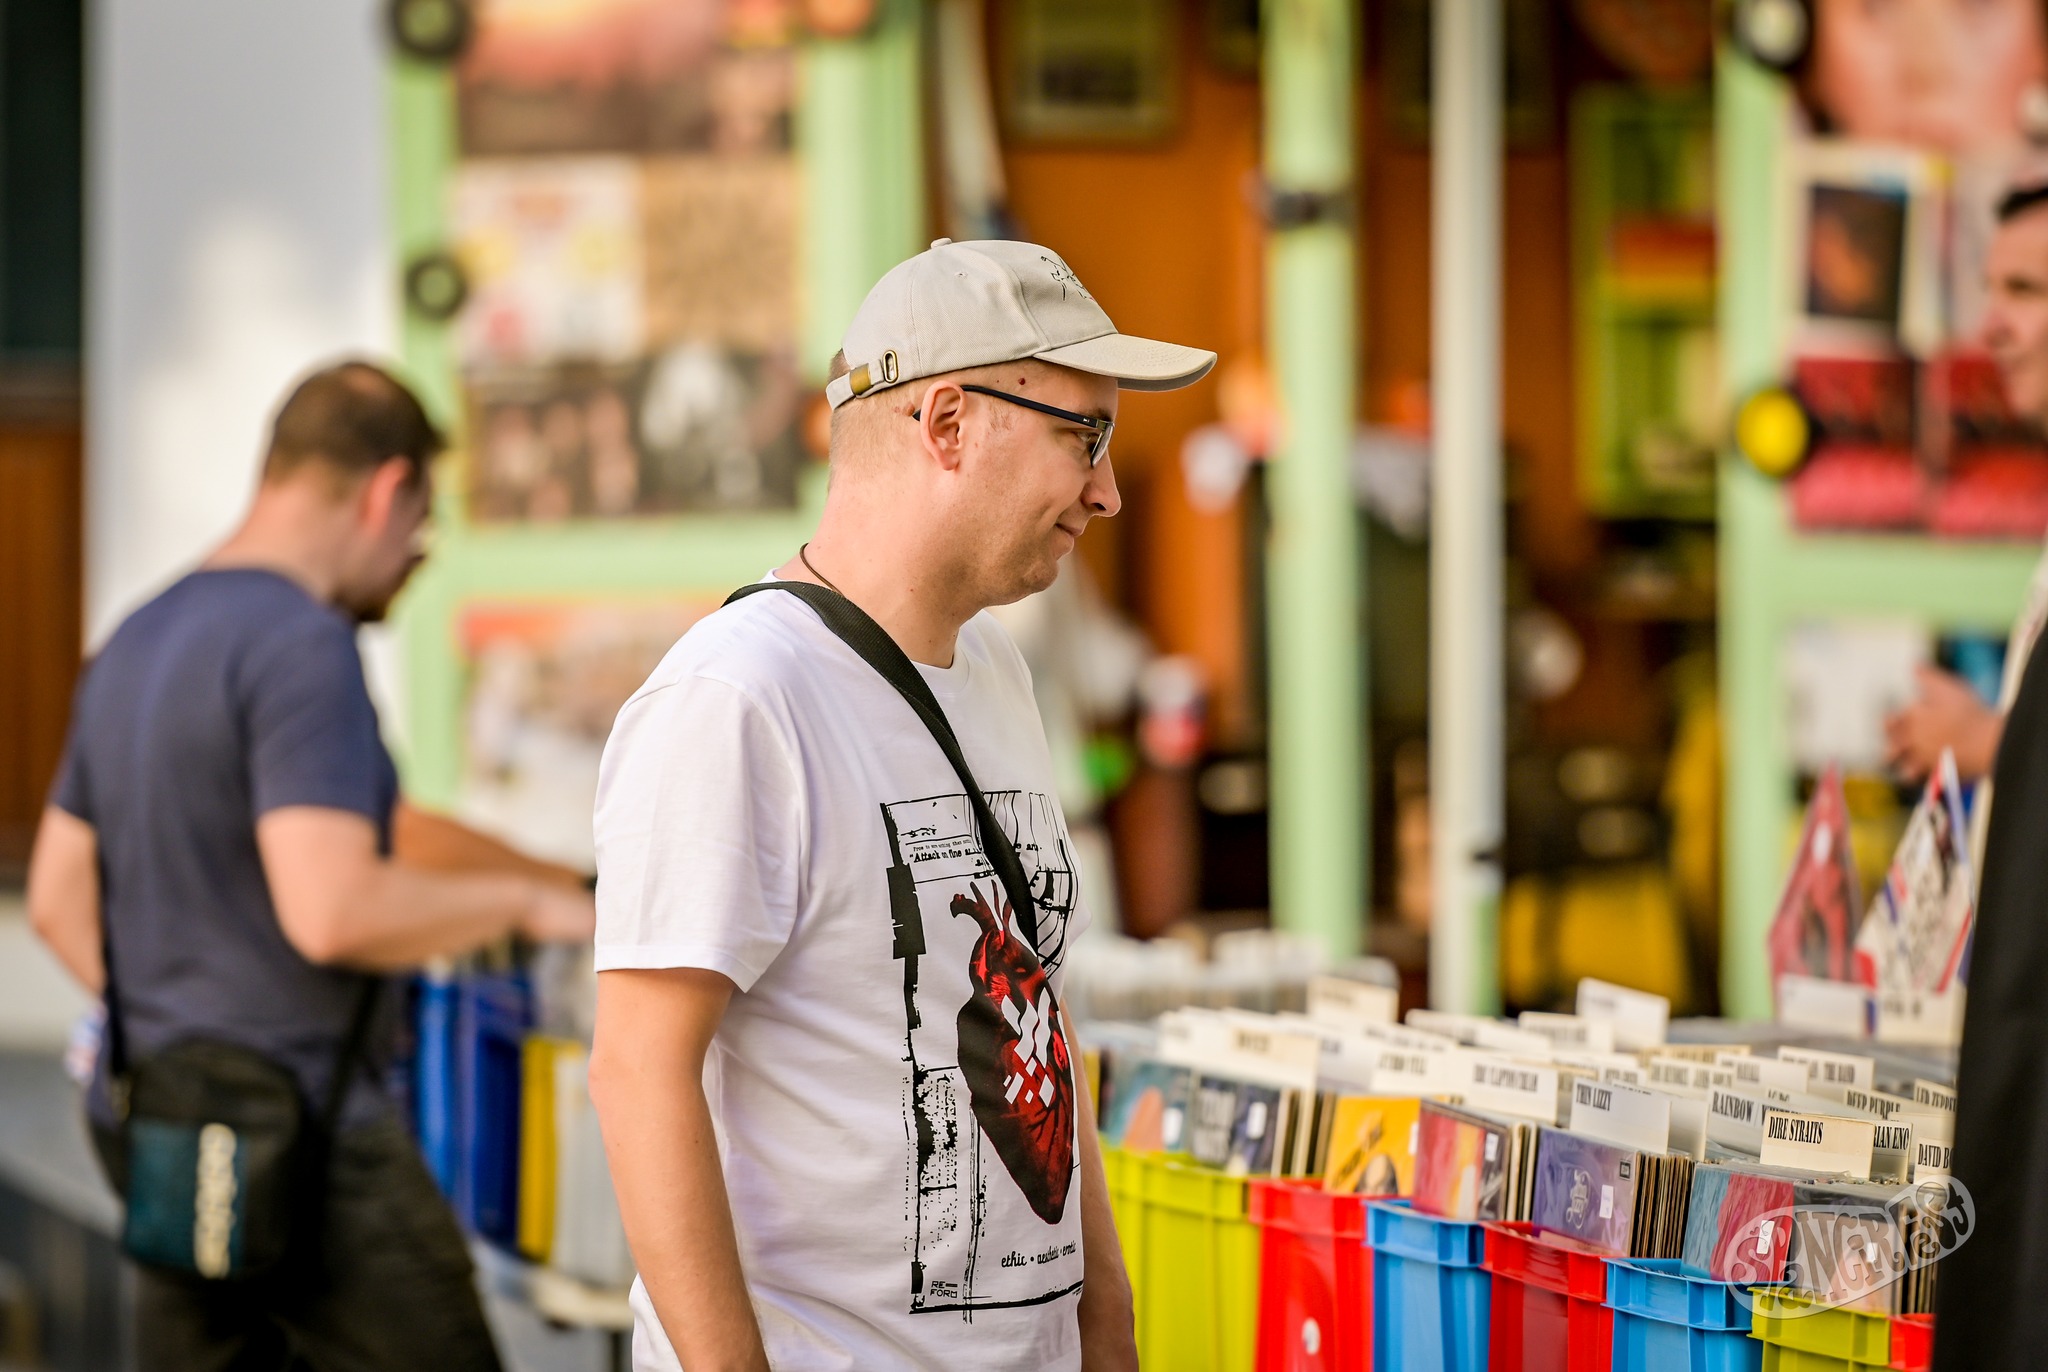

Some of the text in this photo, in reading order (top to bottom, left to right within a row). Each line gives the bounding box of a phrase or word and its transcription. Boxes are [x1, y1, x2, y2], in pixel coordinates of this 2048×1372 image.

[949, 849, 962, 858] fine
[1576, 1083, 1592, 1106] THIN
[1593, 1087, 1612, 1111] LIZZY
[1712, 1091, 1754, 1123] RAINBOW
[1847, 1090, 1868, 1110] DEEP
[1768, 1116, 1824, 1144] DIRE STRAITS
[1892, 1127, 1910, 1150] ENO
[1917, 1143, 1941, 1168] DAVID
[1001, 1250, 1027, 1268] ethic
